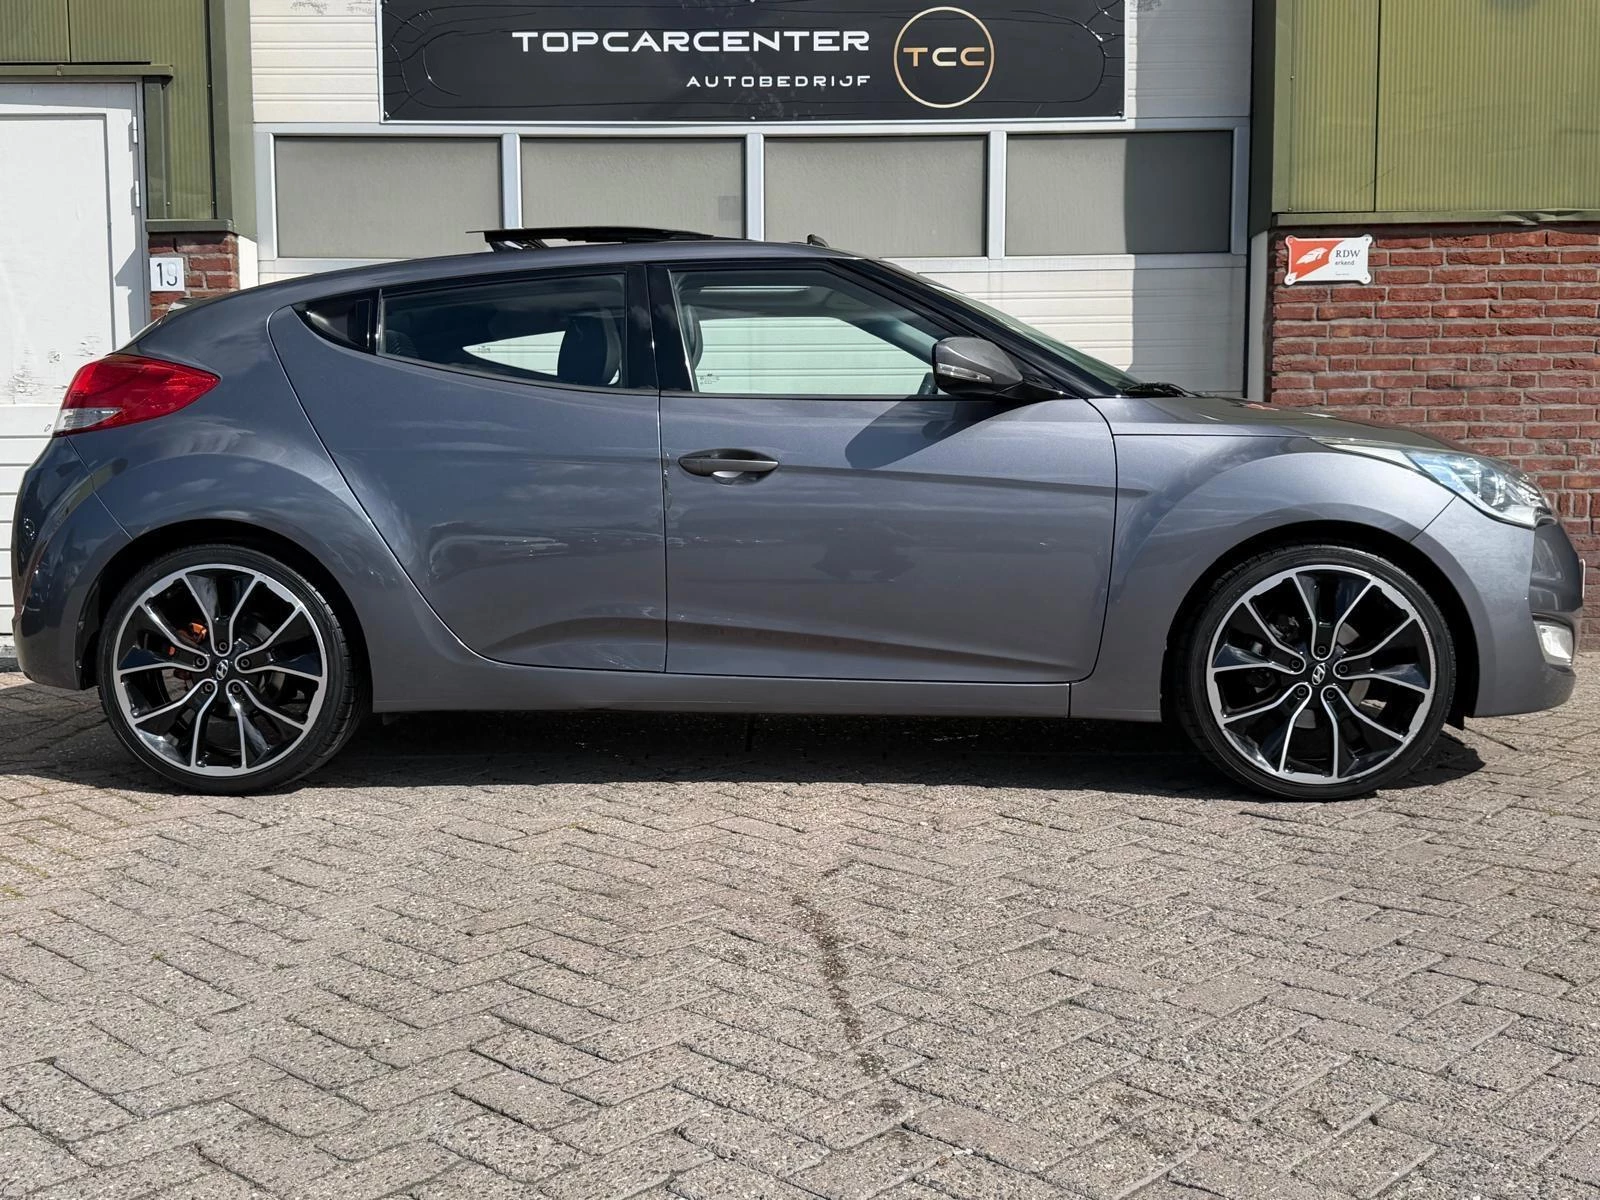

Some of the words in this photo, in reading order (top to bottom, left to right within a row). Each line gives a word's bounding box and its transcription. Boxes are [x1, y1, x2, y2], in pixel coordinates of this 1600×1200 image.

[512, 31, 870, 53] TOPCARCENTER
[902, 46, 986, 68] TCC
[686, 75, 871, 88] AUTOBEDRIJF
[1335, 249, 1361, 258] RDW
